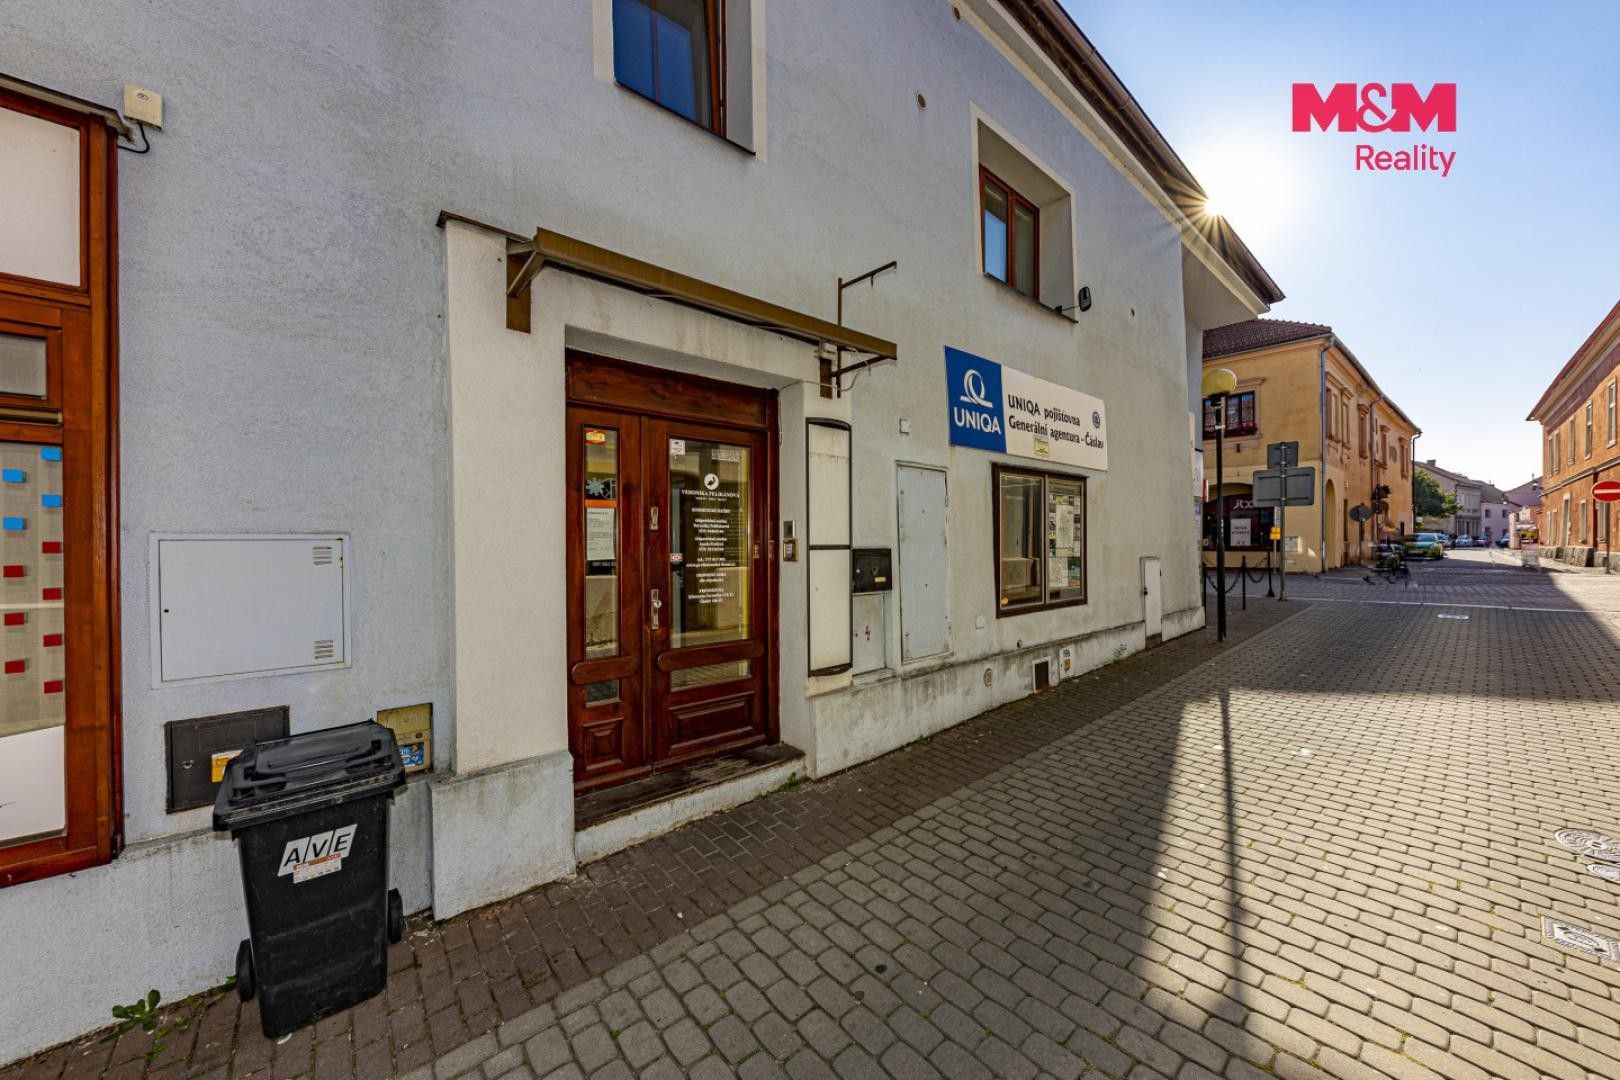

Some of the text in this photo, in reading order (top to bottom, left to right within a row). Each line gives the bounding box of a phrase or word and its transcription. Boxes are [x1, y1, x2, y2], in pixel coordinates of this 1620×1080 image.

[1008, 394, 1041, 416] UNIQA
[953, 406, 1002, 435] UNIQA
[1008, 415, 1048, 436] Generální
[1050, 428, 1080, 443] agentura
[283, 832, 351, 867] AVE
